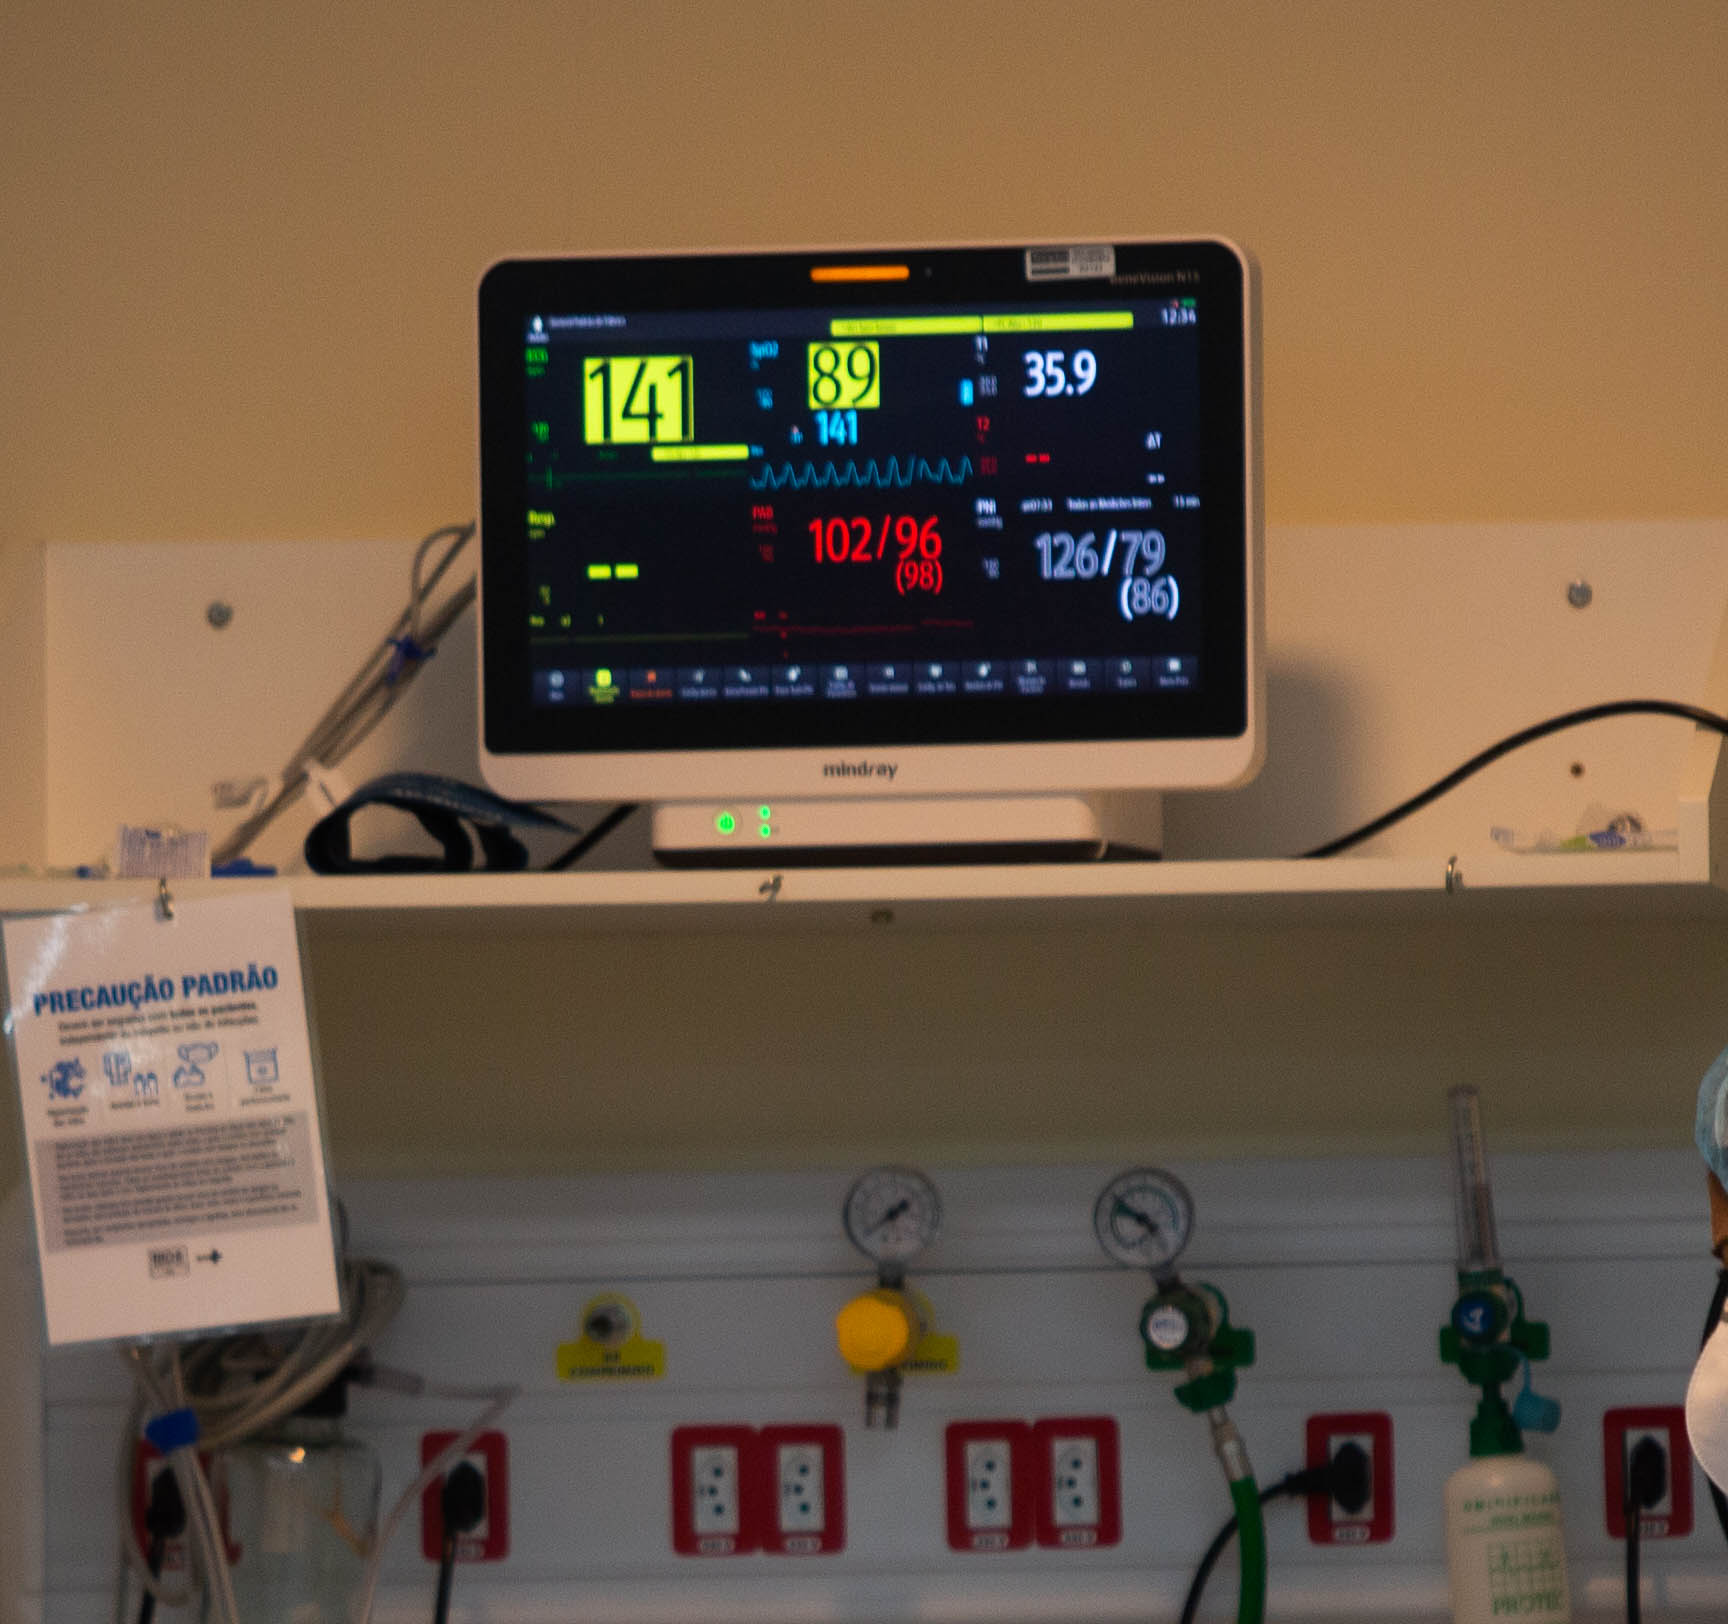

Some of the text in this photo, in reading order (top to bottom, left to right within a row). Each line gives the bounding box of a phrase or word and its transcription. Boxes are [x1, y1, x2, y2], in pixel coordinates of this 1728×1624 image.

[812, 345, 878, 407] 89
[1023, 349, 1097, 398] 35.9
[588, 358, 693, 442] 141
[814, 409, 859, 446] 141
[809, 514, 943, 564] 102/96
[1034, 528, 1167, 580] 126/79
[895, 559, 943, 596] (98)
[1120, 575, 1179, 621] (86)
[823, 760, 898, 782] mindray
[33, 963, 279, 1016] PRECAUÇÃO PADRÃO
